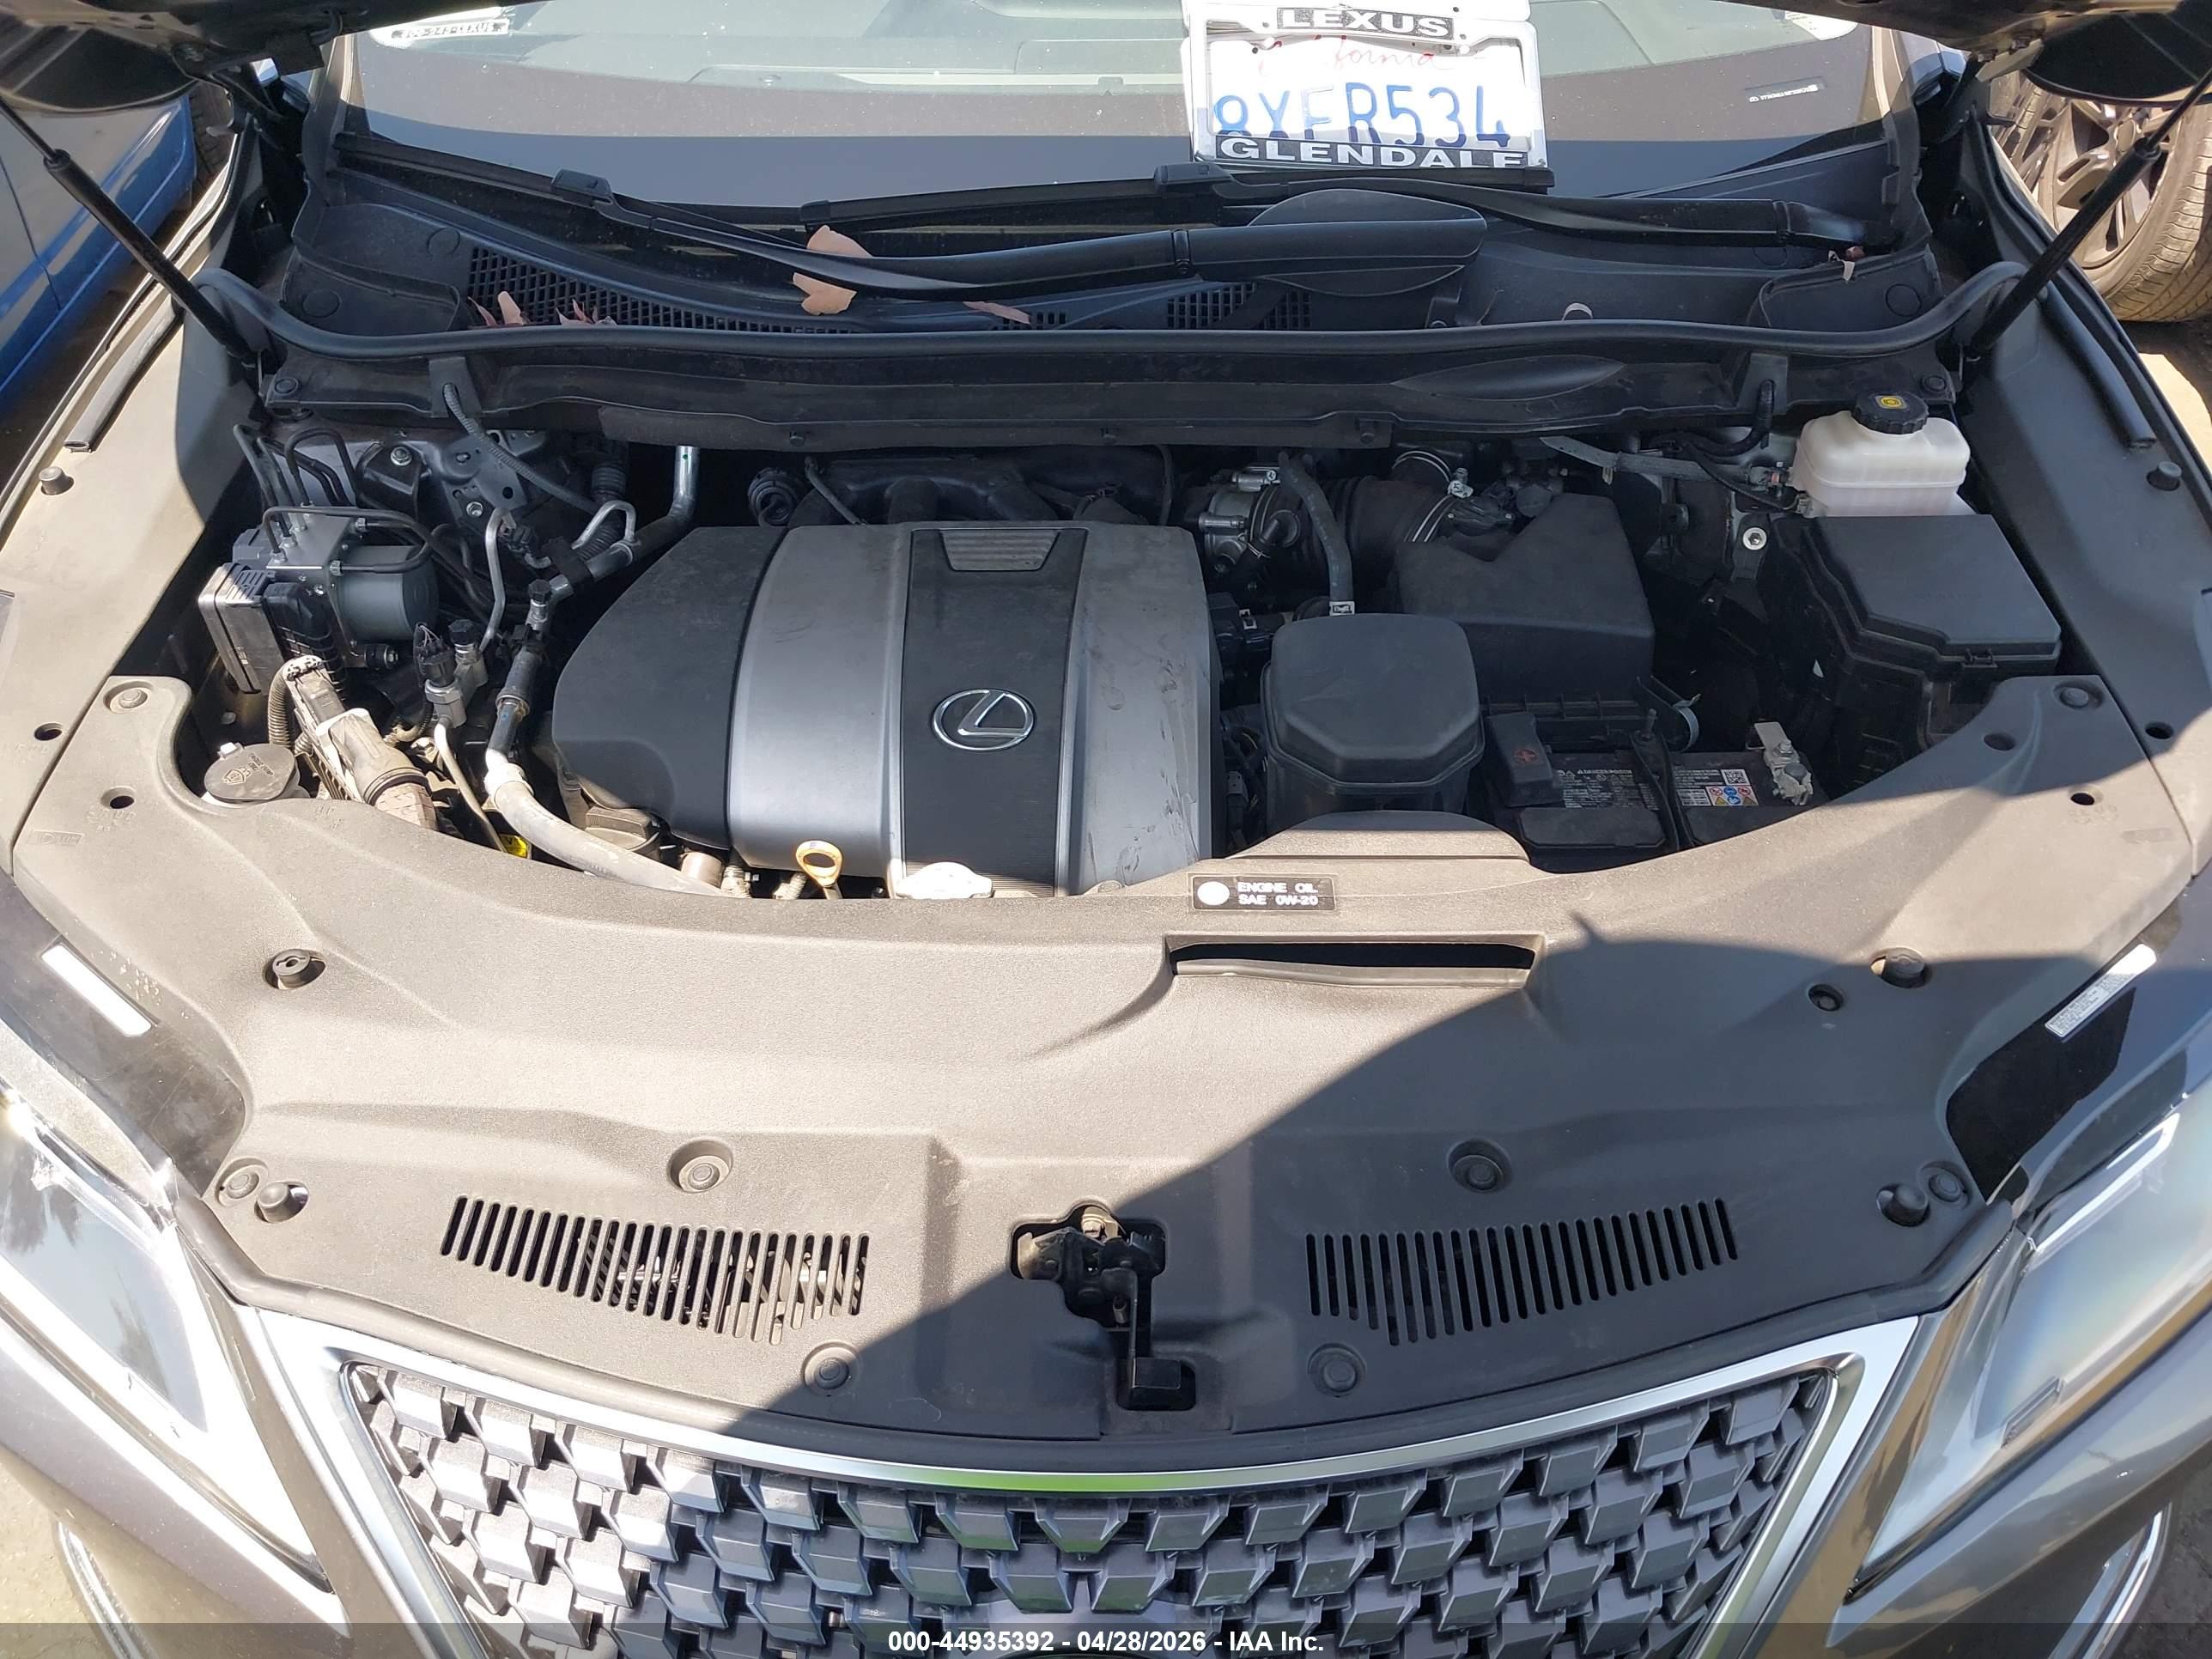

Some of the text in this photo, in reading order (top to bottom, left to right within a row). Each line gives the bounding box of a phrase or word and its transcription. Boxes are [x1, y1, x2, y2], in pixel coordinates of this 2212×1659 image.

[1282, 9, 1449, 37] LEXUS
[1237, 881, 1319, 894] ENGINE OIL
[1237, 894, 1319, 906] SAE 0W-20
